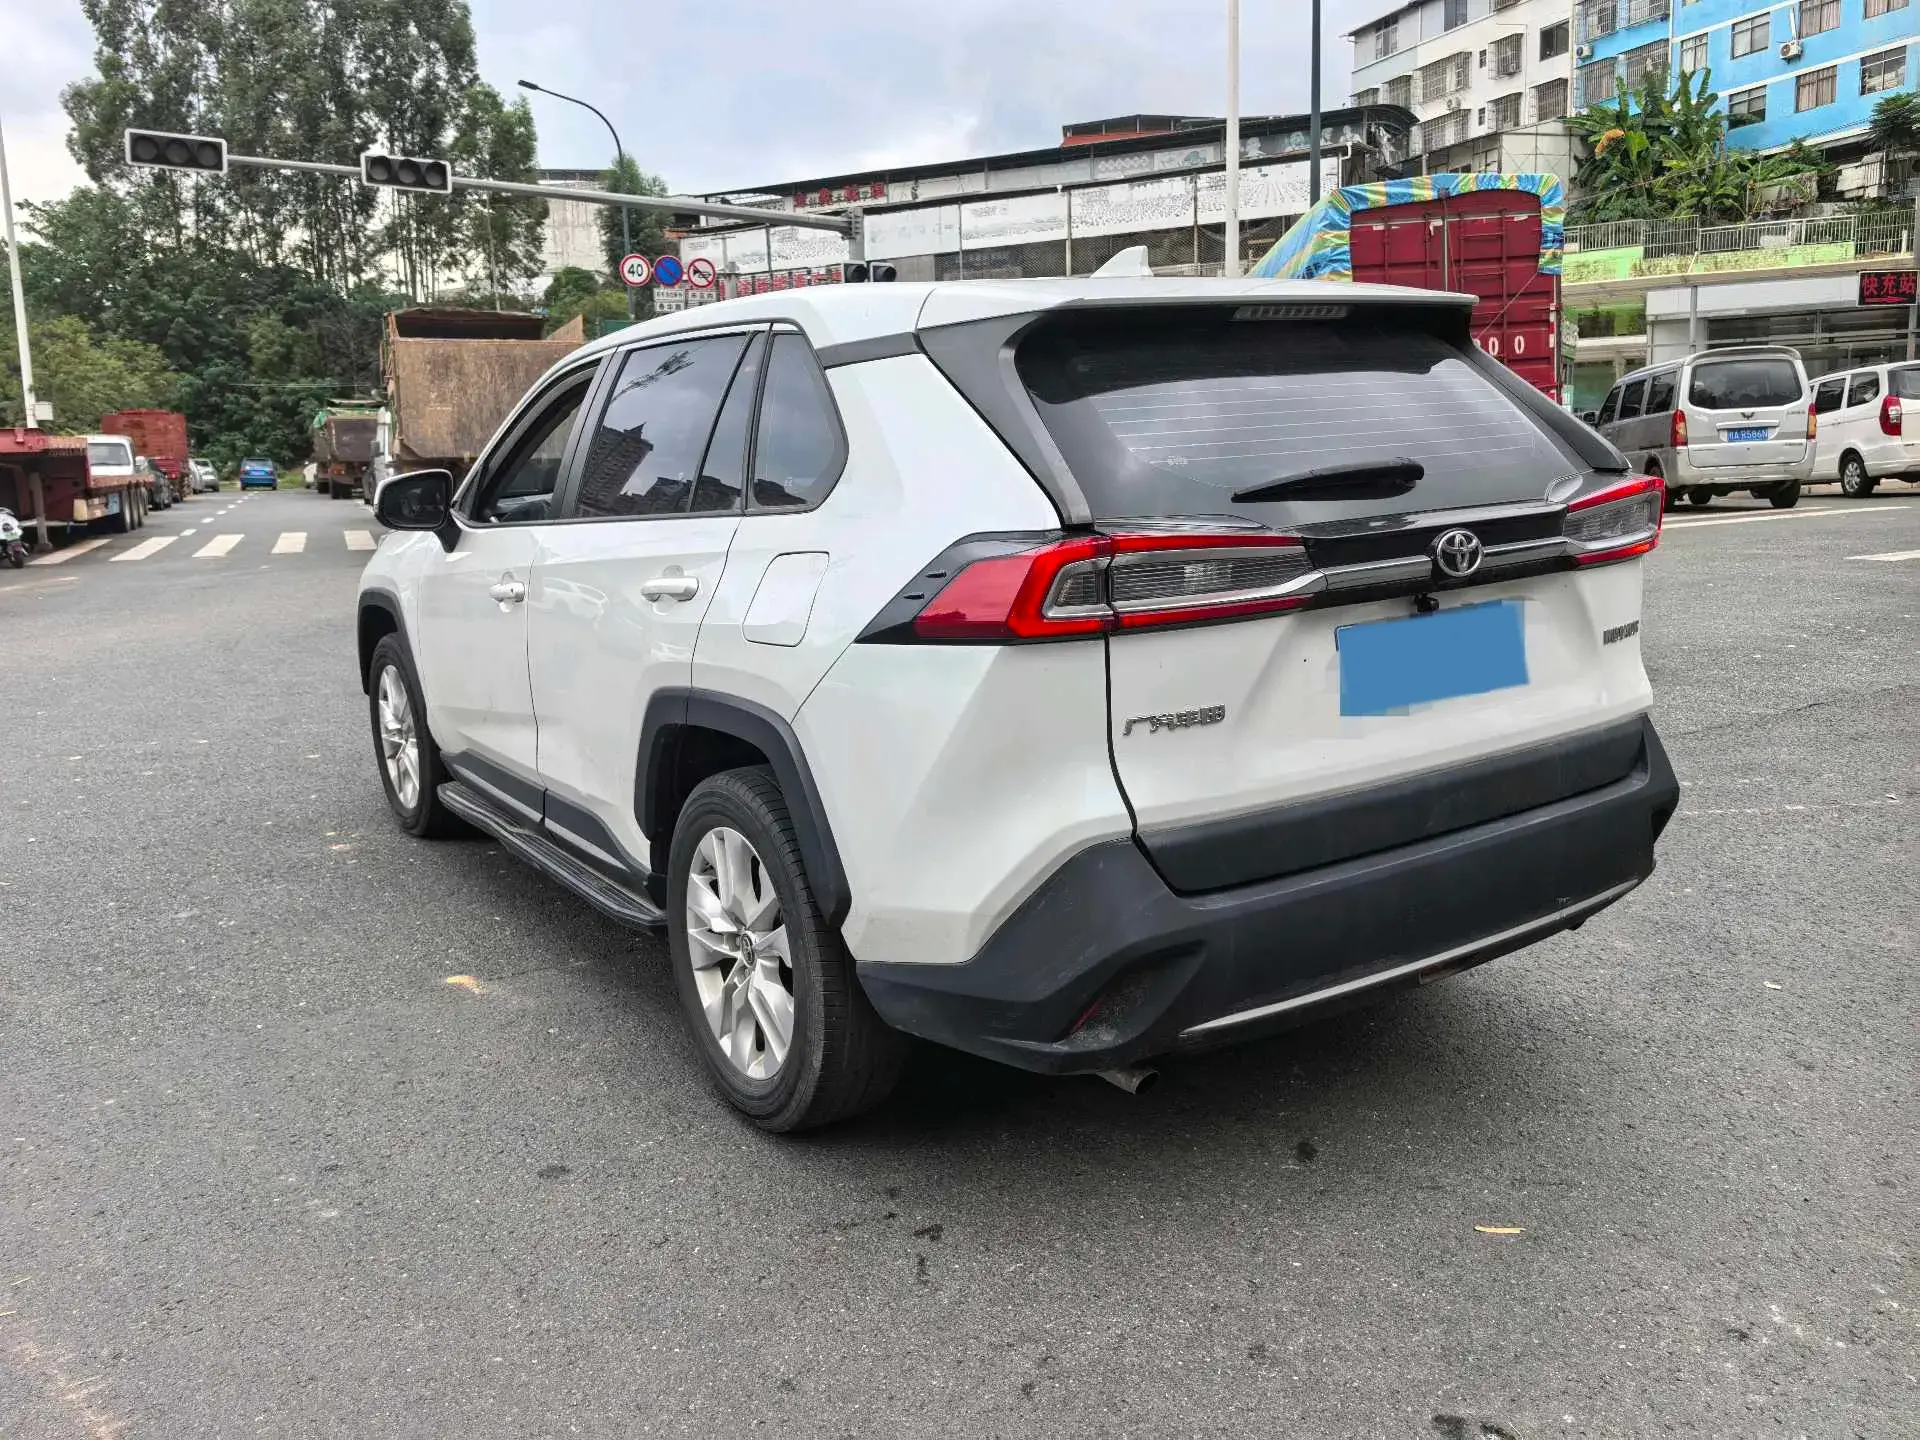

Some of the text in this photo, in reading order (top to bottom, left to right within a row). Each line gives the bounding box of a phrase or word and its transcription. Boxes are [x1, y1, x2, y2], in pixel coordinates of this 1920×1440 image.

[627, 263, 644, 277] 40
[1862, 273, 1915, 295] 快充站
